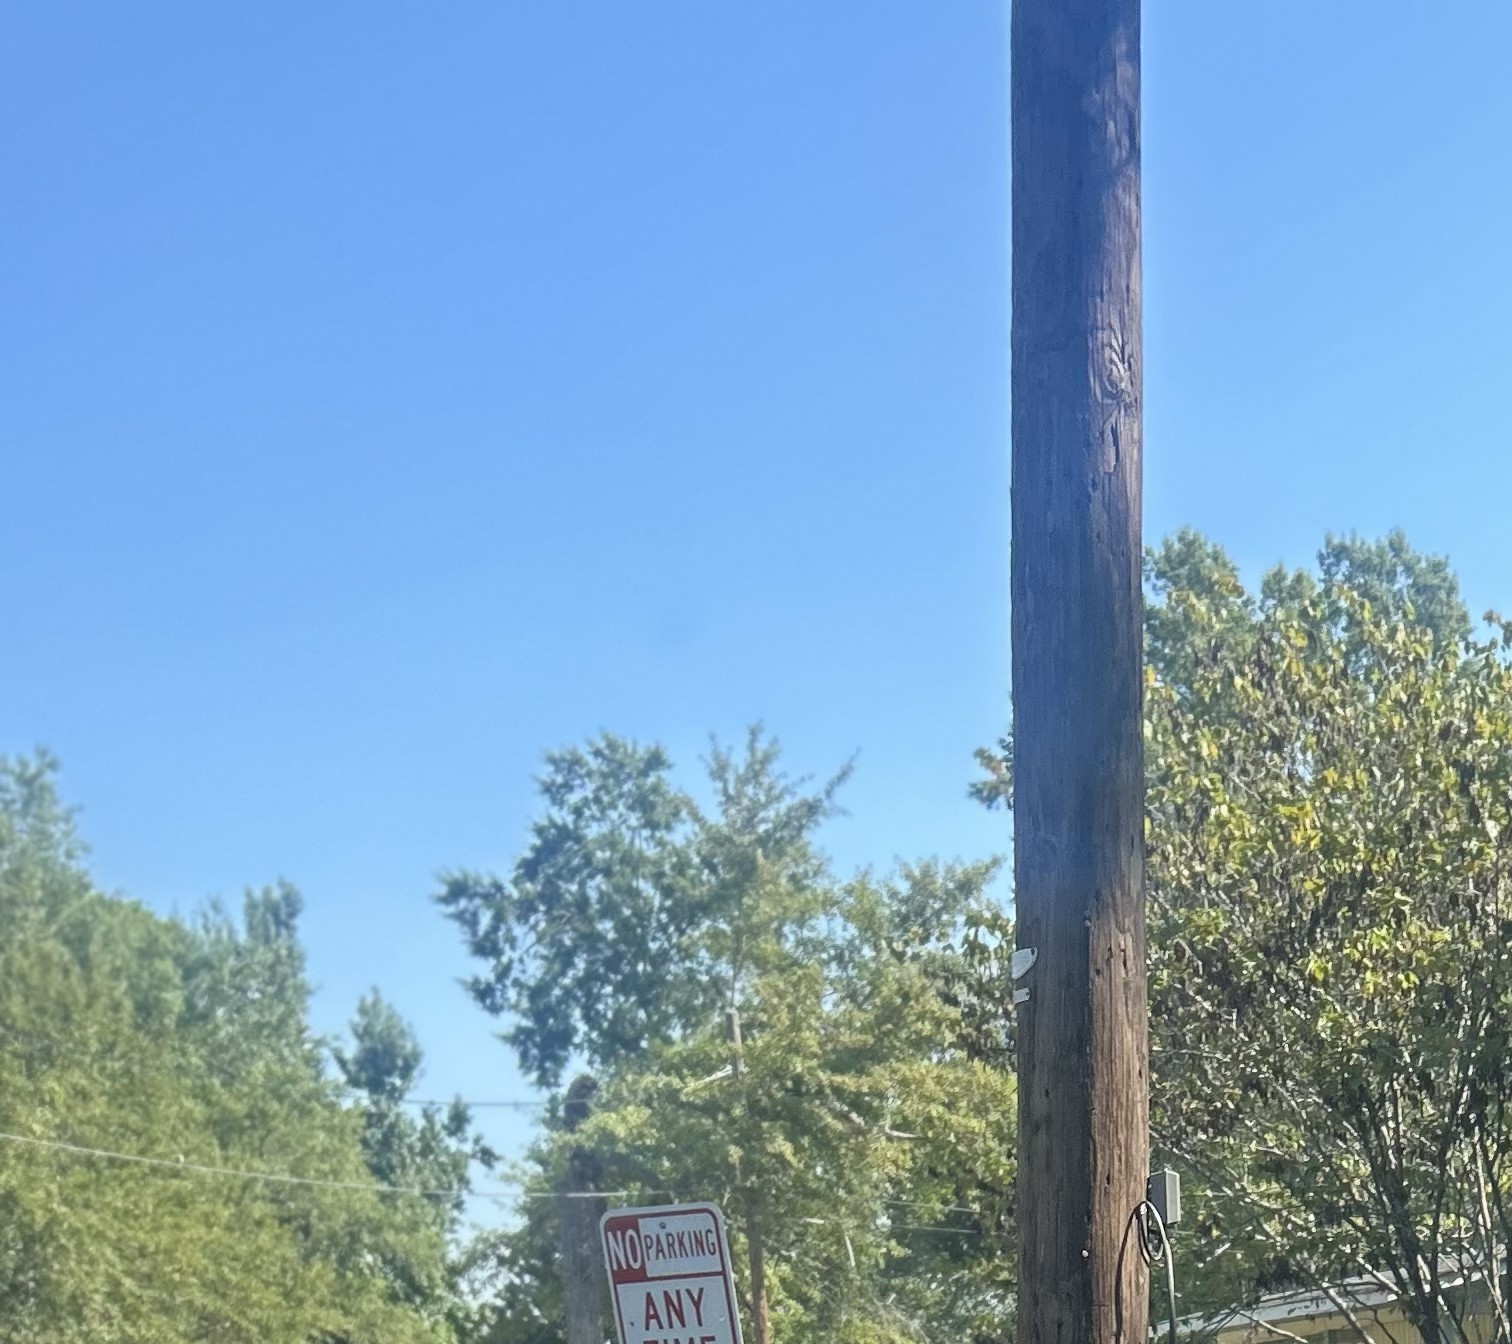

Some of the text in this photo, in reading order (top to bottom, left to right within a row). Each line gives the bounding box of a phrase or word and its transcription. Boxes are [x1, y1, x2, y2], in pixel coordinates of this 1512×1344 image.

[607, 1228, 717, 1270] NO PARKING
[645, 1287, 705, 1331] ANY
